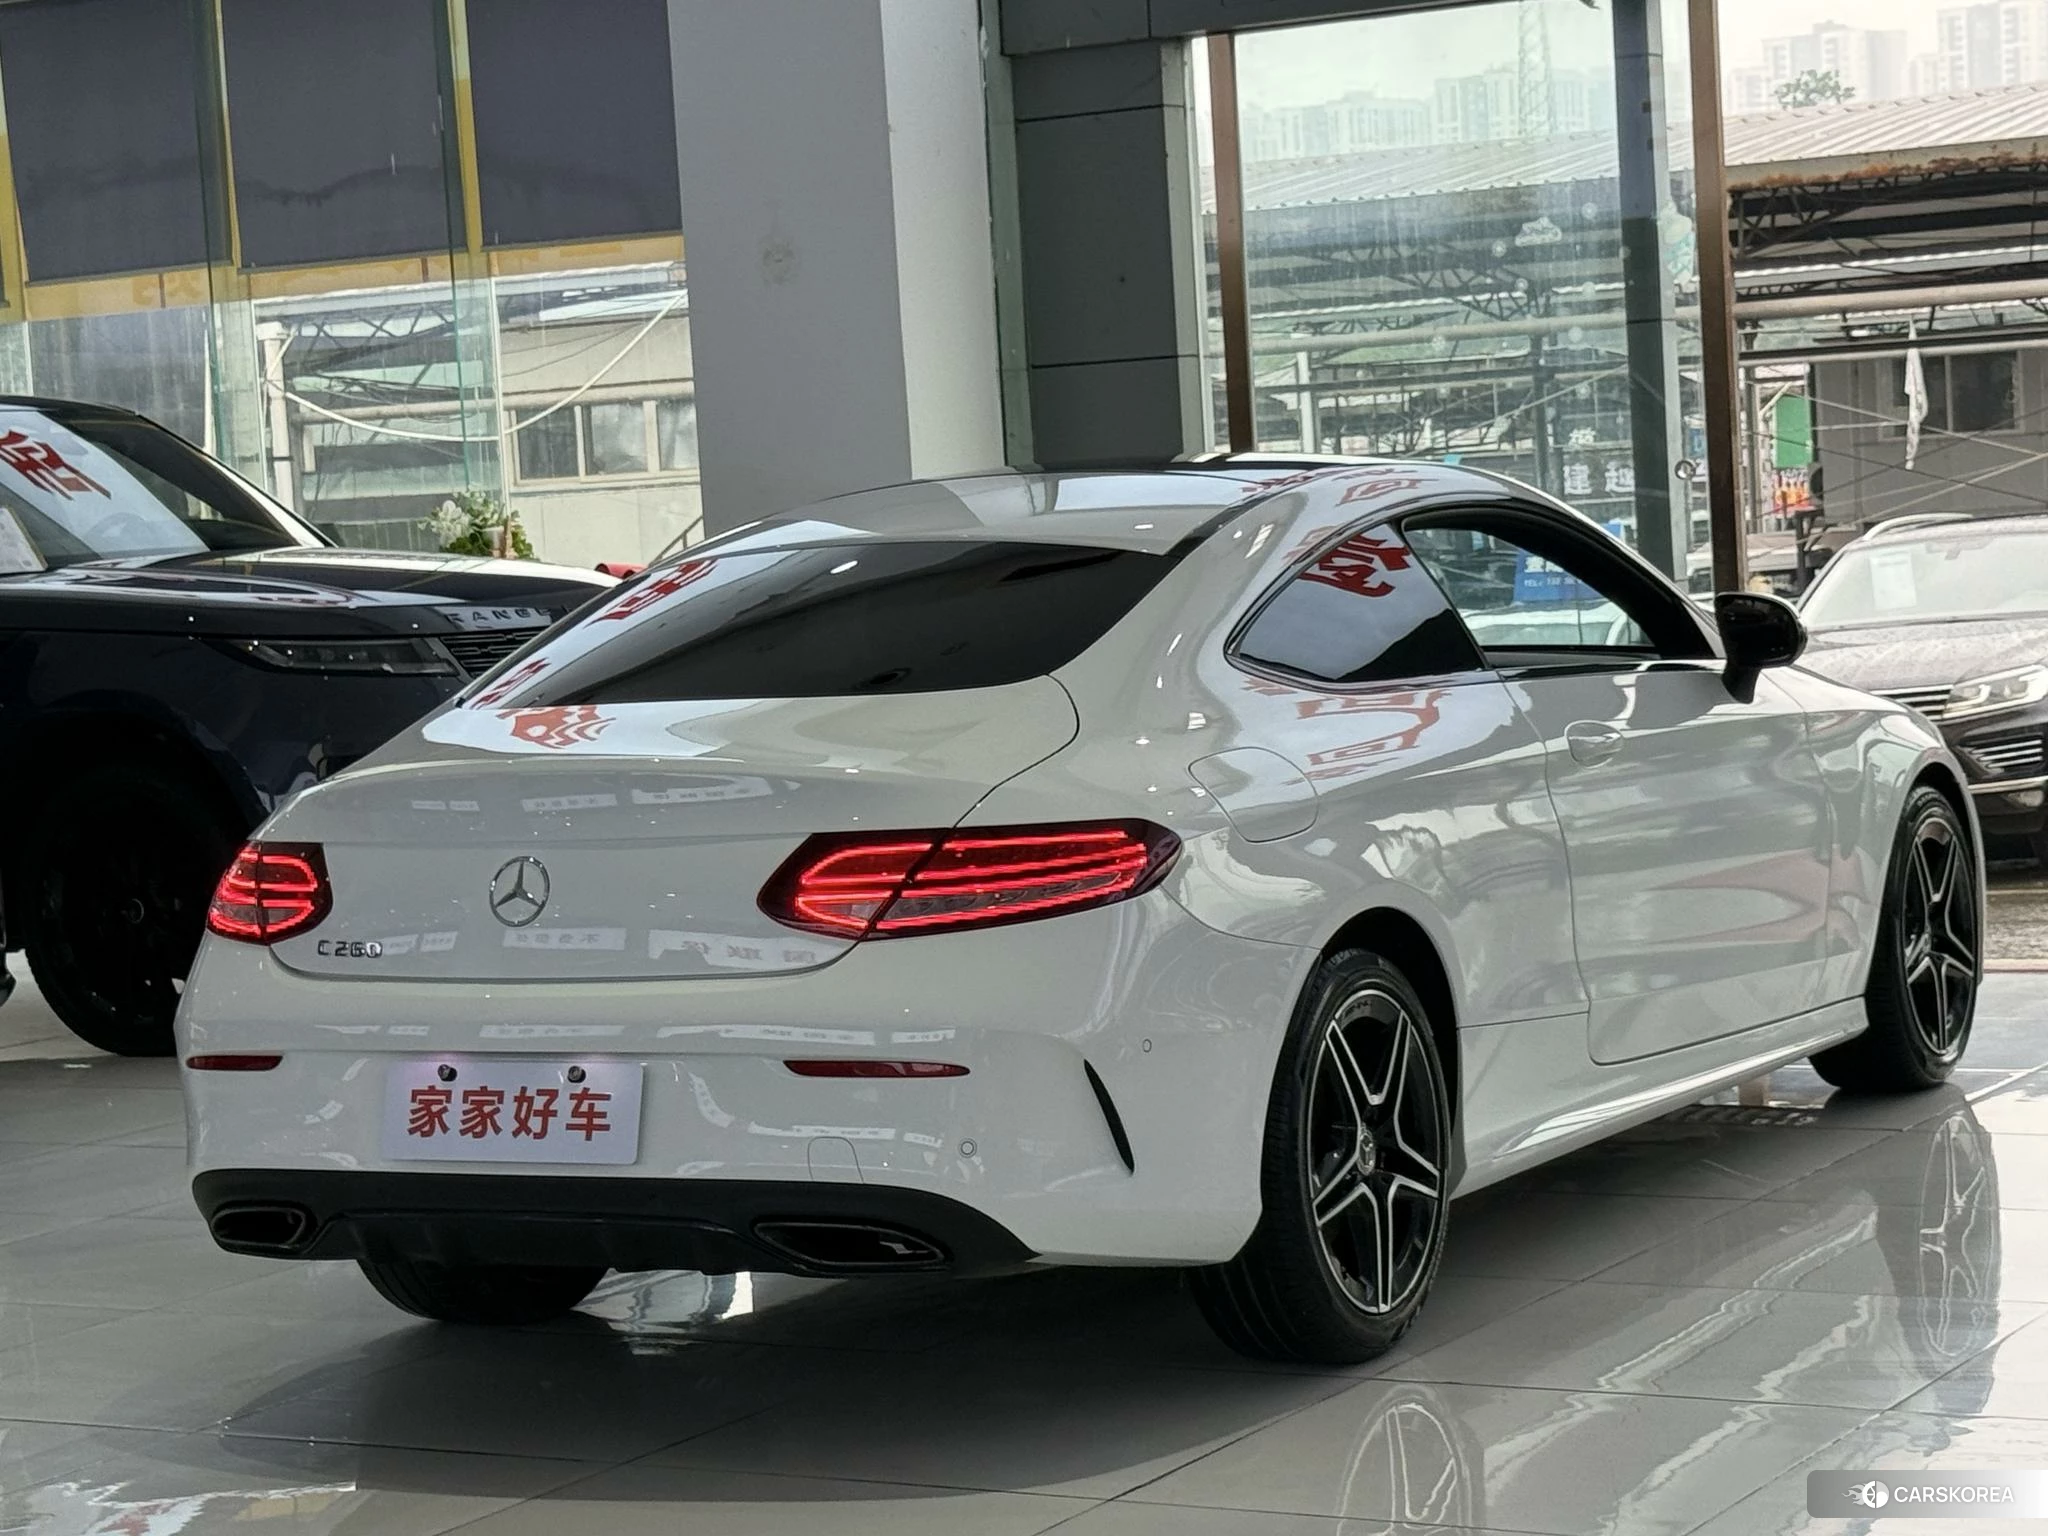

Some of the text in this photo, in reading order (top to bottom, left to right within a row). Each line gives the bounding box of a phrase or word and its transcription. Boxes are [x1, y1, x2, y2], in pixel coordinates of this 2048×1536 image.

[317, 940, 383, 958] C260
[407, 1085, 612, 1141] 家家好车
